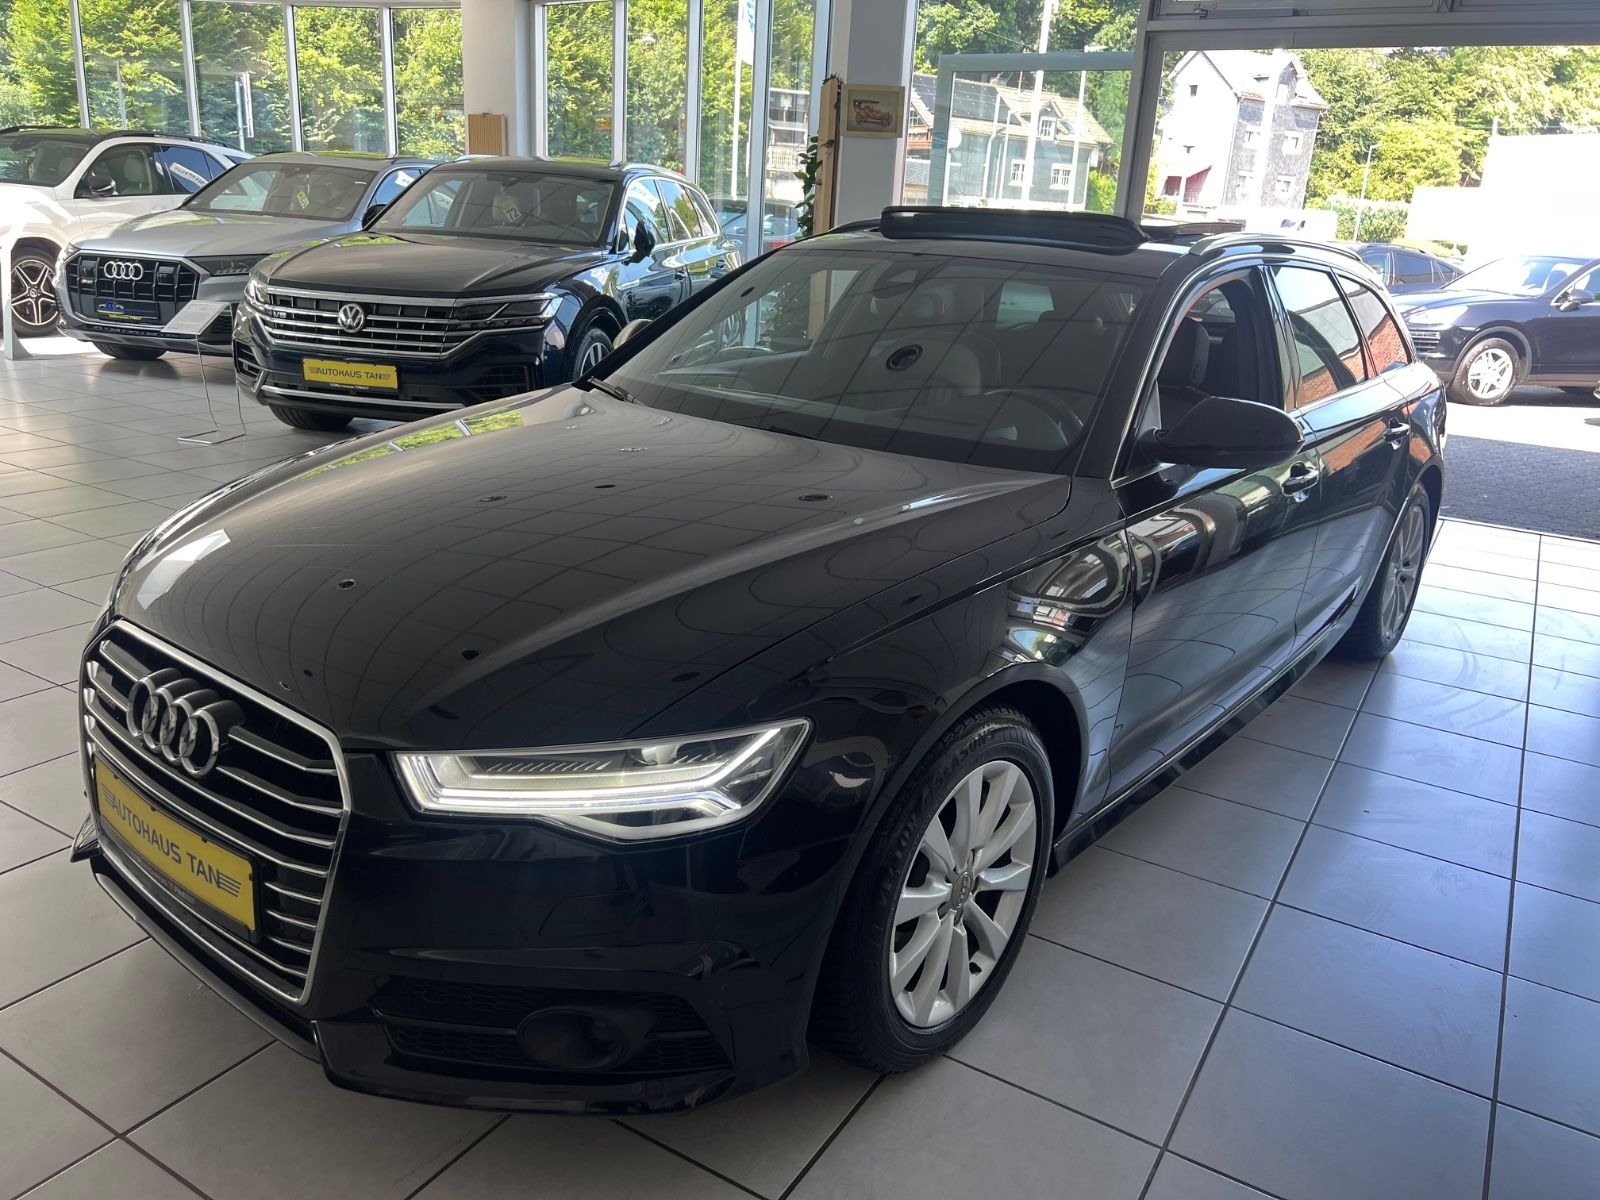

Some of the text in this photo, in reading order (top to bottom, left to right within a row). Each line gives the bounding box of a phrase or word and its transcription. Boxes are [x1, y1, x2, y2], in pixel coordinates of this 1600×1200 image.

[316, 368, 382, 380] AUTOHAUS TAN
[112, 797, 182, 865] AUTOHAUS
[186, 852, 221, 889] TAN
